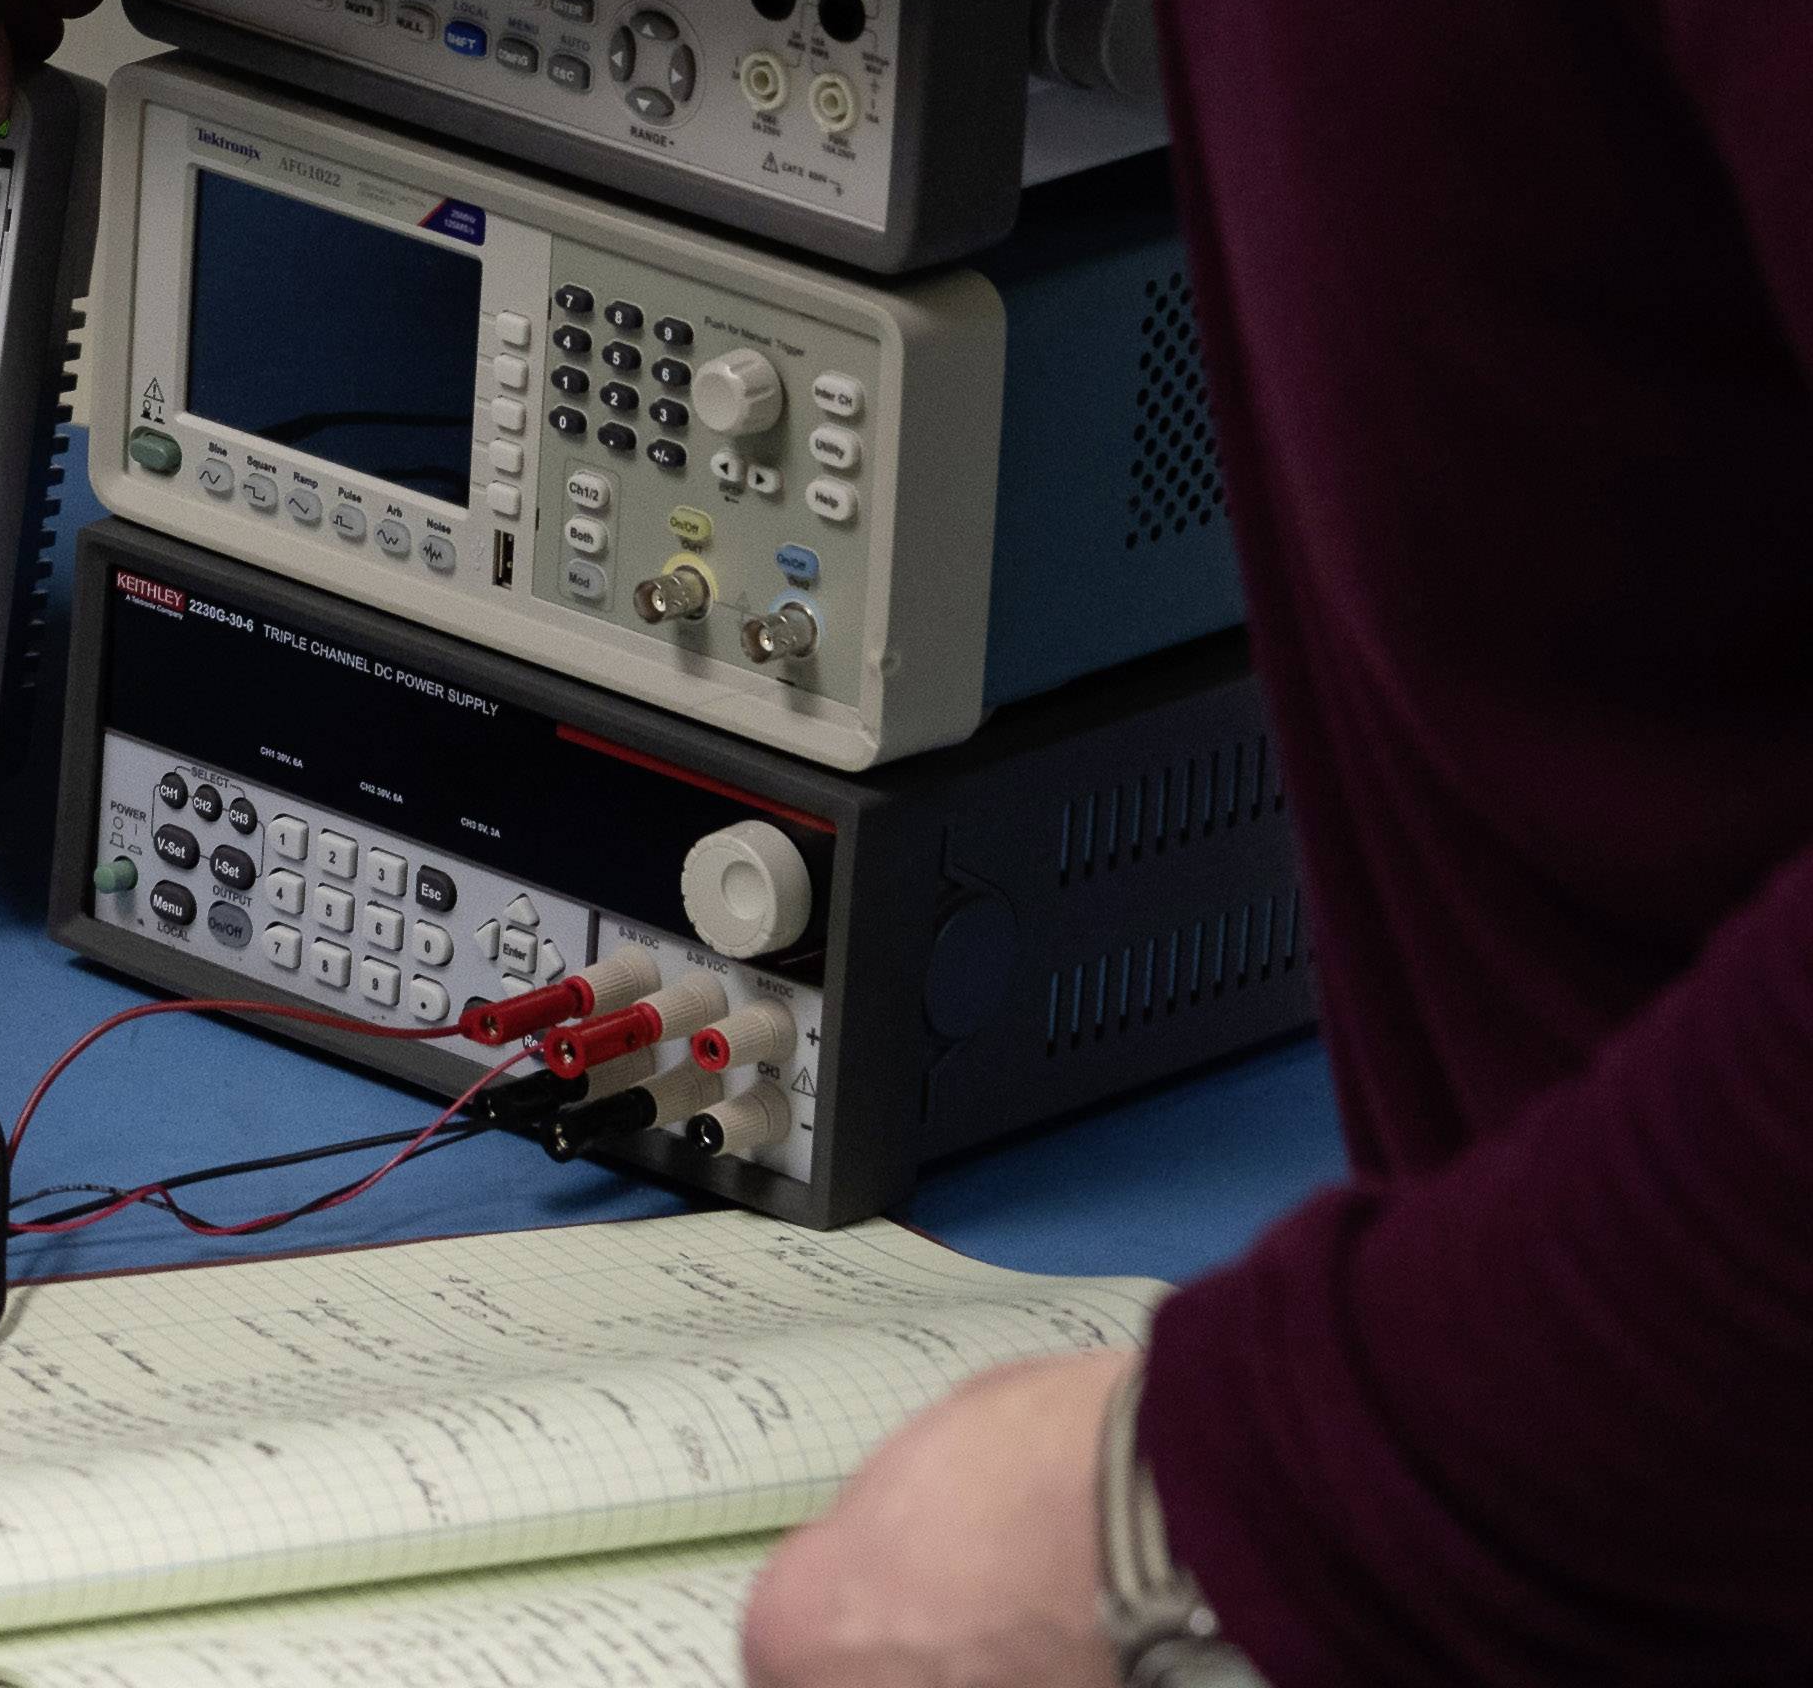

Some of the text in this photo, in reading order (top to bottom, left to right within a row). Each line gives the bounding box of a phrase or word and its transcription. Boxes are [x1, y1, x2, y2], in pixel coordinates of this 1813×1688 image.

[195, 127, 342, 188] Tektronix AFG1022
[338, 486, 362, 504] Pulse
[569, 481, 599, 502] Ch1/2
[426, 517, 452, 535] Noise
[570, 526, 594, 545] Both
[116, 571, 184, 608] KEITHLEY
[189, 598, 254, 633] 2230G-30-6
[263, 624, 308, 652] TRIPLE
[310, 640, 371, 674] CHANNEL
[374, 662, 394, 681] DC
[396, 670, 445, 700] POWER
[447, 688, 500, 718] SUPPLY
[160, 784, 249, 825] CH1 CH2 CH3
[157, 837, 240, 879] V-Set I-Set
[421, 883, 442, 901] Esc
[152, 894, 184, 917] Menu
